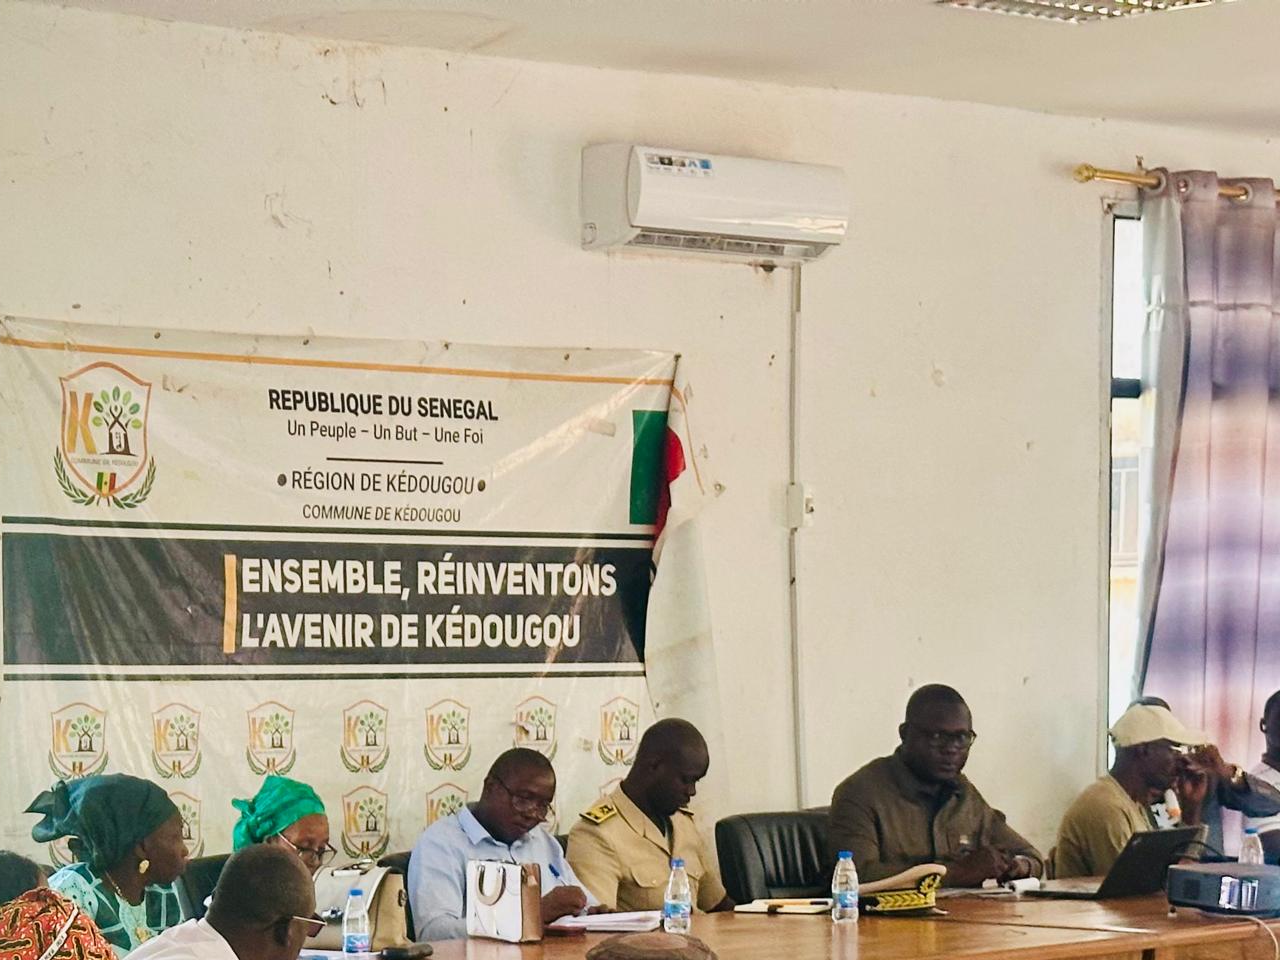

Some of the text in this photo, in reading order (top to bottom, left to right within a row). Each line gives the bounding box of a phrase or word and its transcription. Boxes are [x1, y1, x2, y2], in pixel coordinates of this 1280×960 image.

[268, 389, 499, 421] REPUBLIQUE DU SENEGAL
[287, 419, 306, 436] Un
[310, 421, 357, 442] Peuple
[373, 424, 391, 440] Un
[395, 425, 418, 442] But
[434, 427, 460, 444] Une
[464, 428, 484, 444] Foi
[291, 466, 475, 495] RÉGION DE KÉDOUGOU
[302, 503, 461, 523] COMMUNE DE KÉDOUGOU
[241, 552, 617, 601] ENSEMBLE, RÉINVENTONS
[240, 605, 582, 648] L'AVENIR DE KÉDOUGOU
